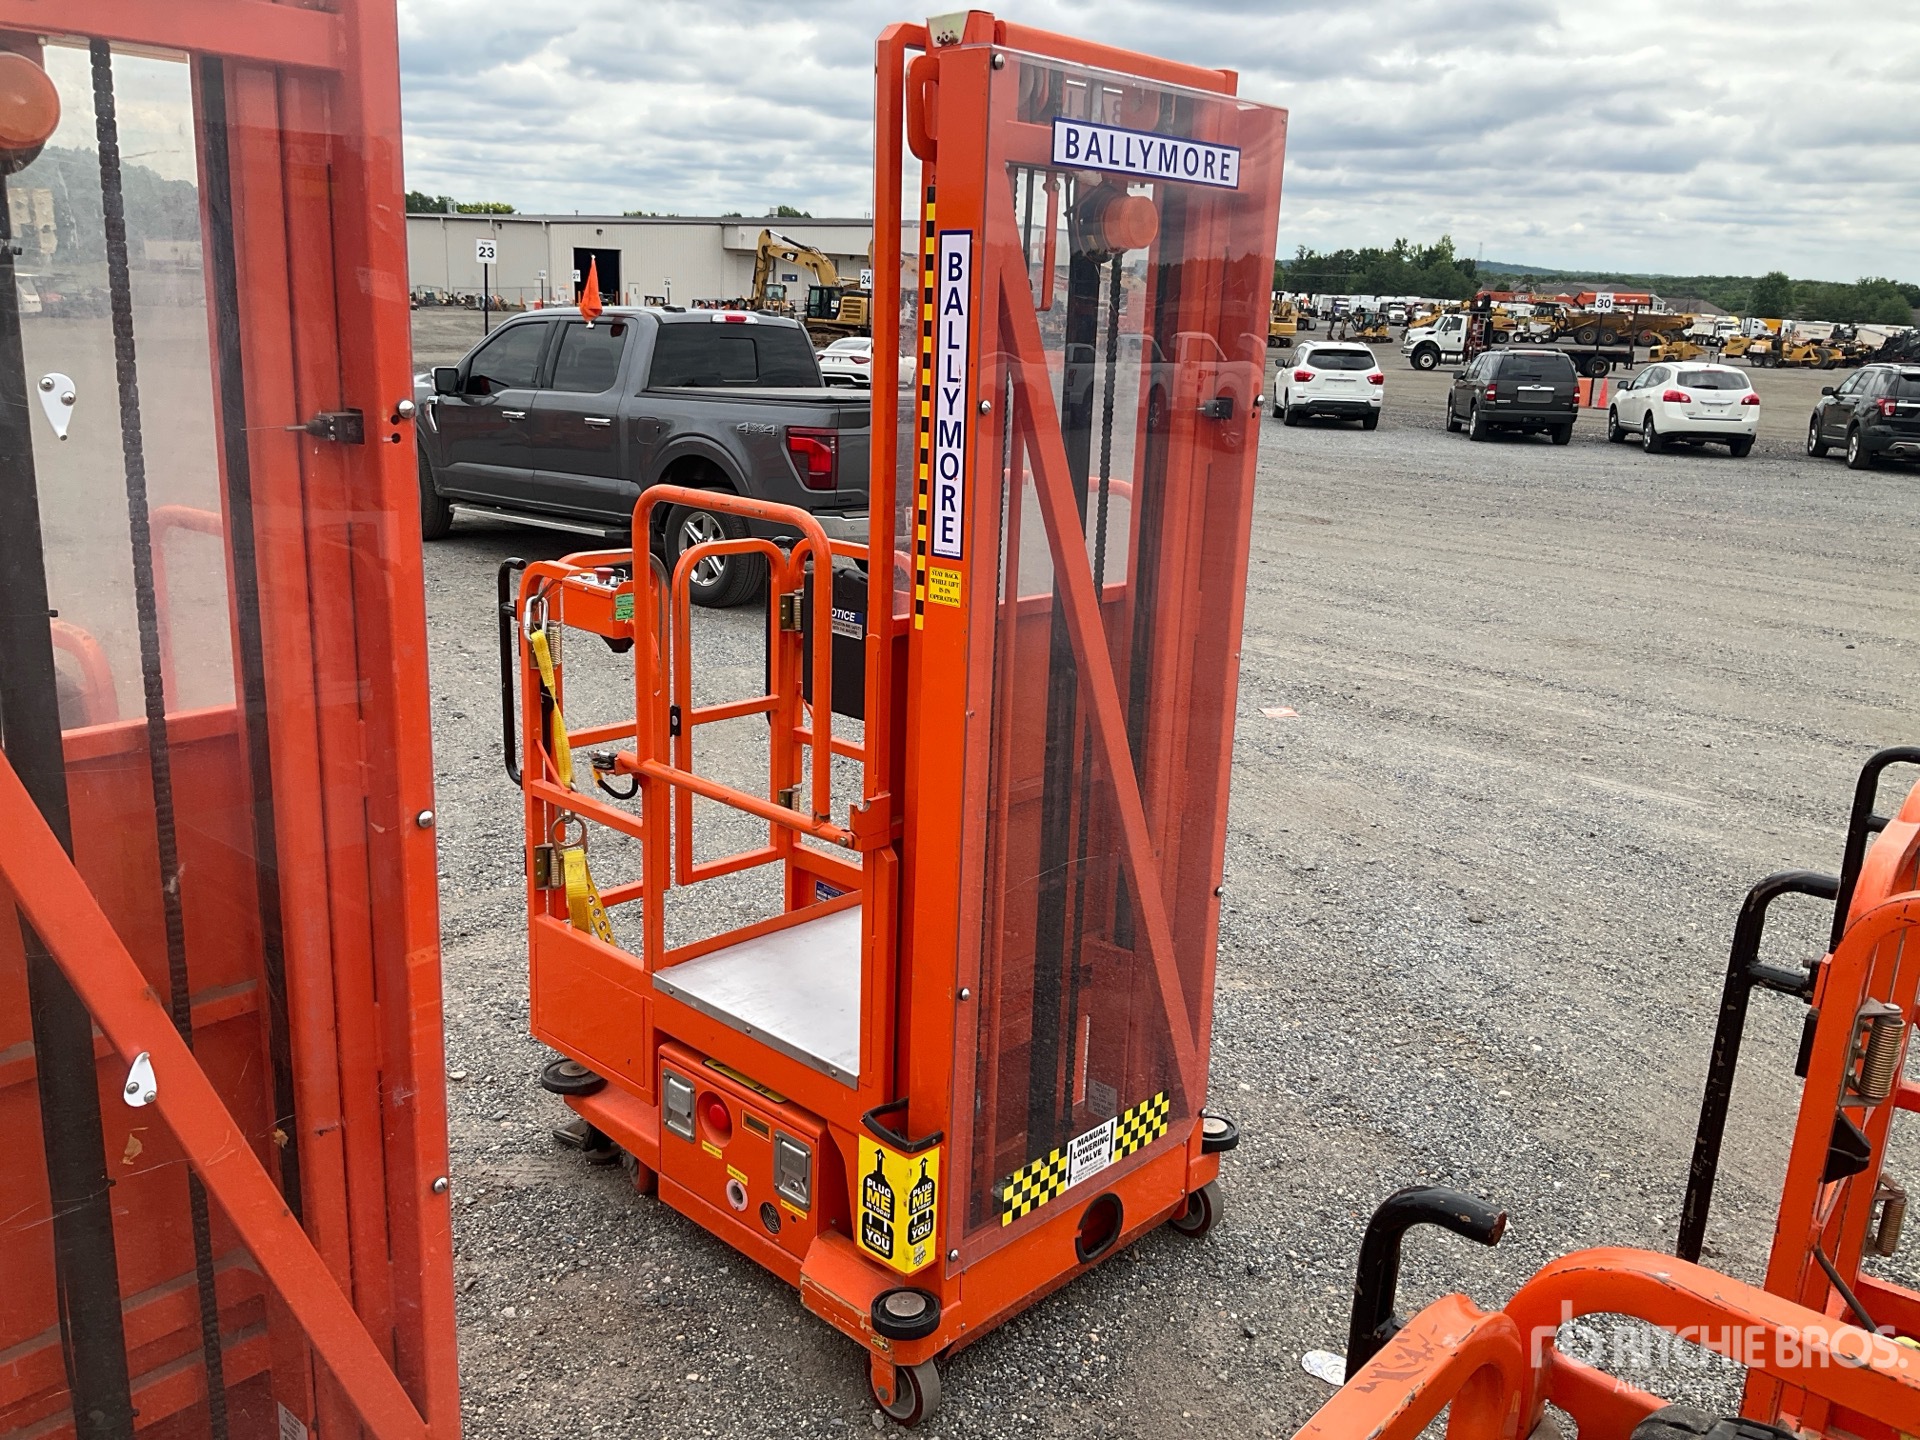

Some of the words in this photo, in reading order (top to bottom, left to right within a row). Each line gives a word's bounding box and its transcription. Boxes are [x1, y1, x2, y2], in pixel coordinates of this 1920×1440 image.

[1065, 127, 1231, 182] BALLYMORE
[478, 246, 495, 259] 23
[861, 274, 871, 285] 24
[830, 300, 839, 308] CAT
[1596, 298, 1611, 309] 30
[939, 252, 963, 543] BALLYMORE
[930, 577, 947, 586] WHILE
[944, 572, 959, 580] BACK
[929, 593, 959, 604] OPERATION
[831, 607, 856, 622] OTICE
[1076, 1125, 1107, 1149] MANUAL
[1073, 1133, 1110, 1160] LOWERING
[1079, 1147, 1103, 1166] VALVE
[866, 1177, 892, 1198] PLUG
[912, 1181, 933, 1198] PLUG
[866, 1187, 891, 1213] ME
[912, 1189, 932, 1210] ME
[866, 1201, 873, 1209] IN
[873, 1205, 891, 1219] TODAY
[911, 1221, 931, 1239] YOU
[865, 1228, 890, 1251] YOU
